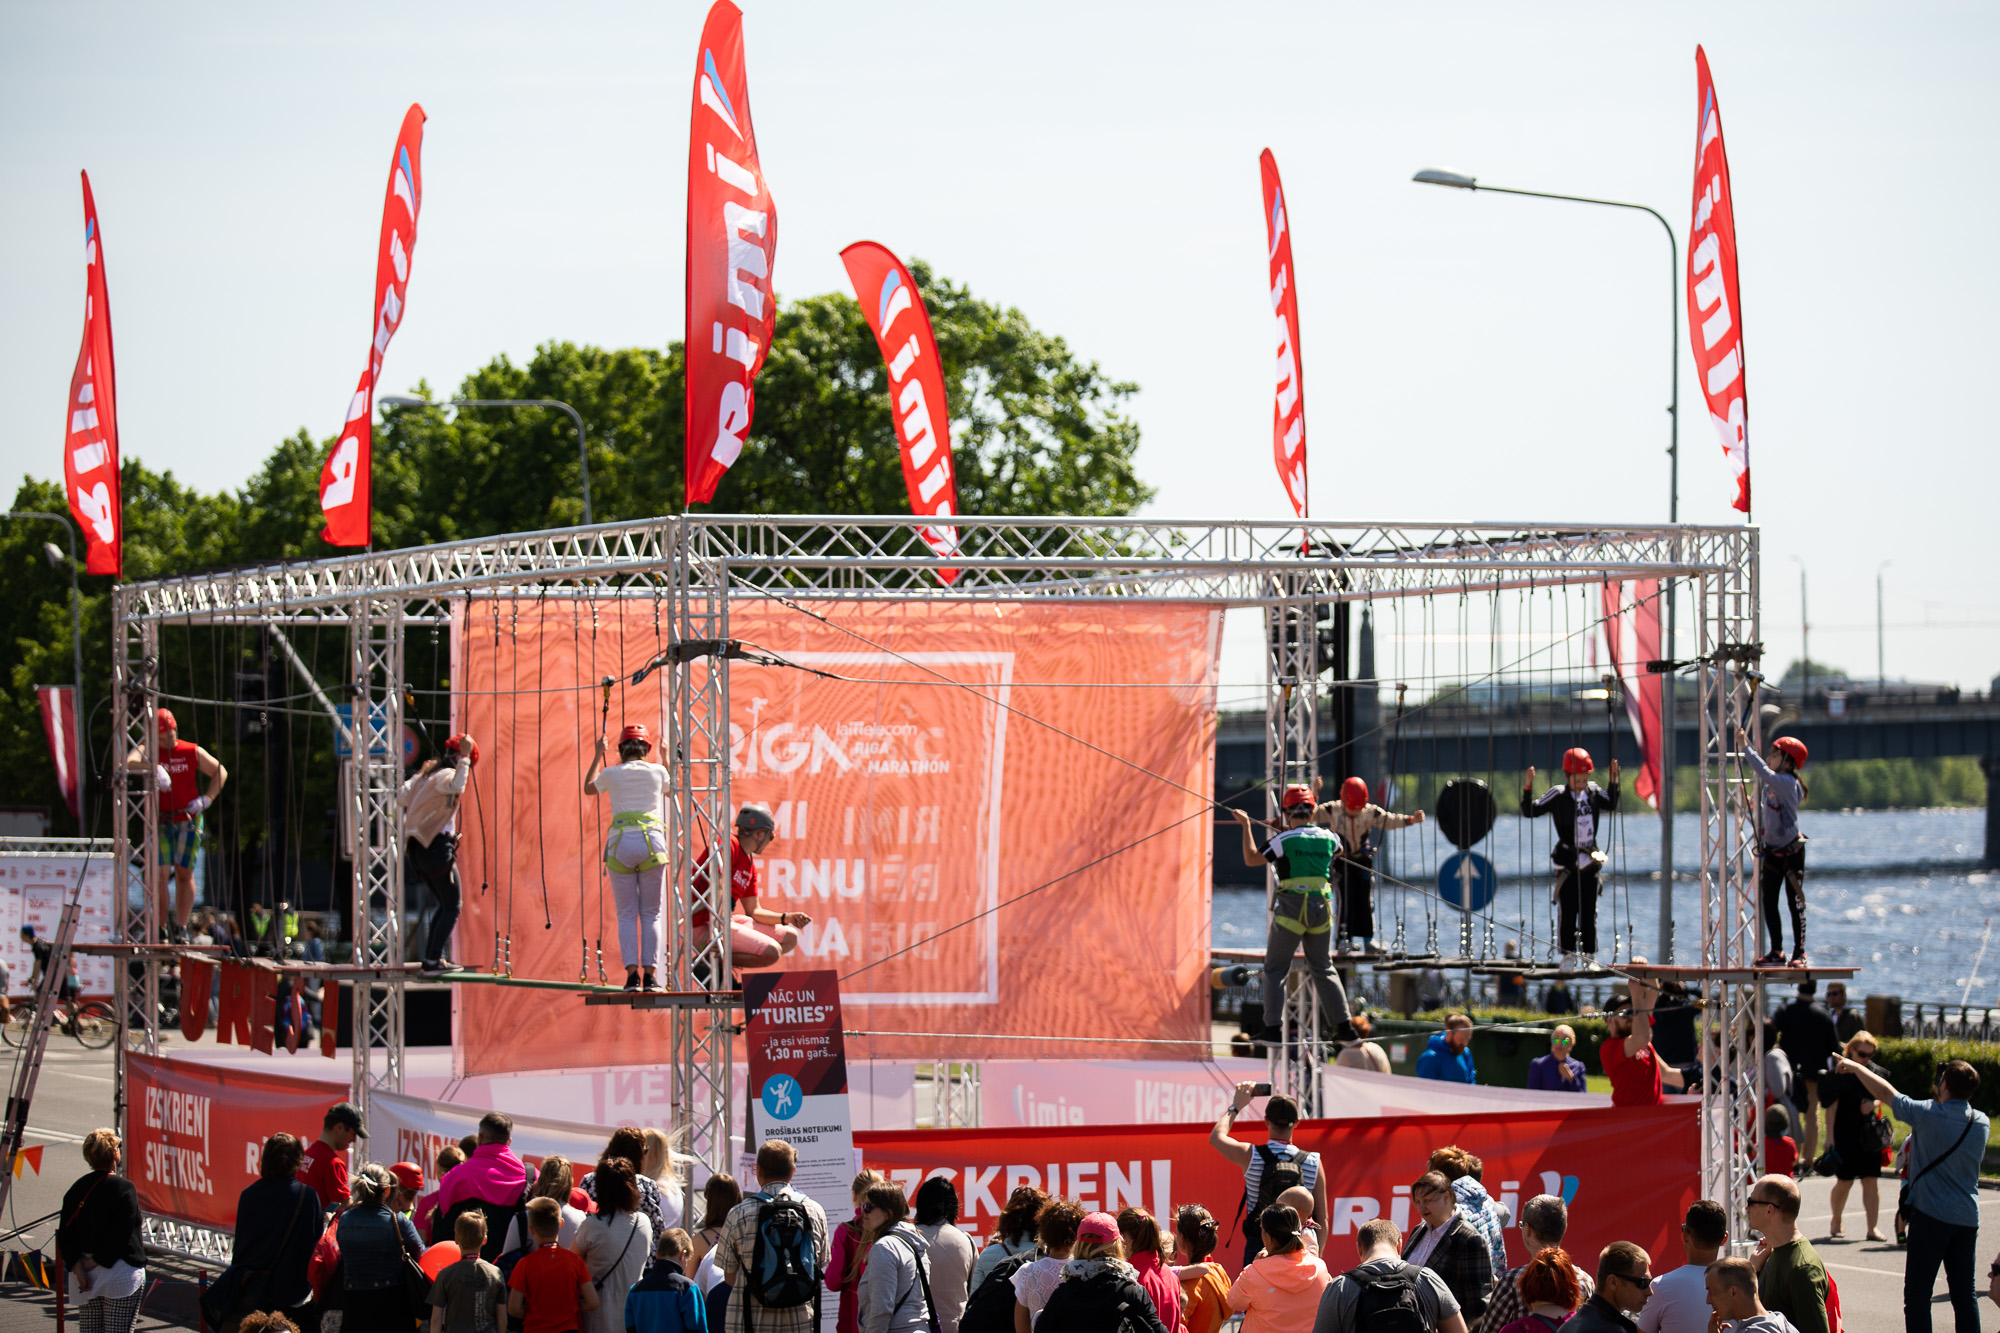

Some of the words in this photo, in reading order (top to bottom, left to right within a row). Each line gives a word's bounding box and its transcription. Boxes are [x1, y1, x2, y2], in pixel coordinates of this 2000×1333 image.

[855, 741, 890, 755] RIGA
[867, 760, 950, 774] MARATHON
[768, 989, 794, 1004] NĀC
[797, 990, 815, 1002] UN
[781, 1037, 795, 1046] esi
[797, 1035, 830, 1045] vismaz
[766, 1048, 790, 1062] 1,30
[793, 1050, 804, 1059] m
[765, 1126, 801, 1136] DROŠĪBAS
[803, 1124, 842, 1134] NOTEIKUMI
[793, 1135, 819, 1144] TRASEI
[1332, 1181, 1520, 1235] Rii
